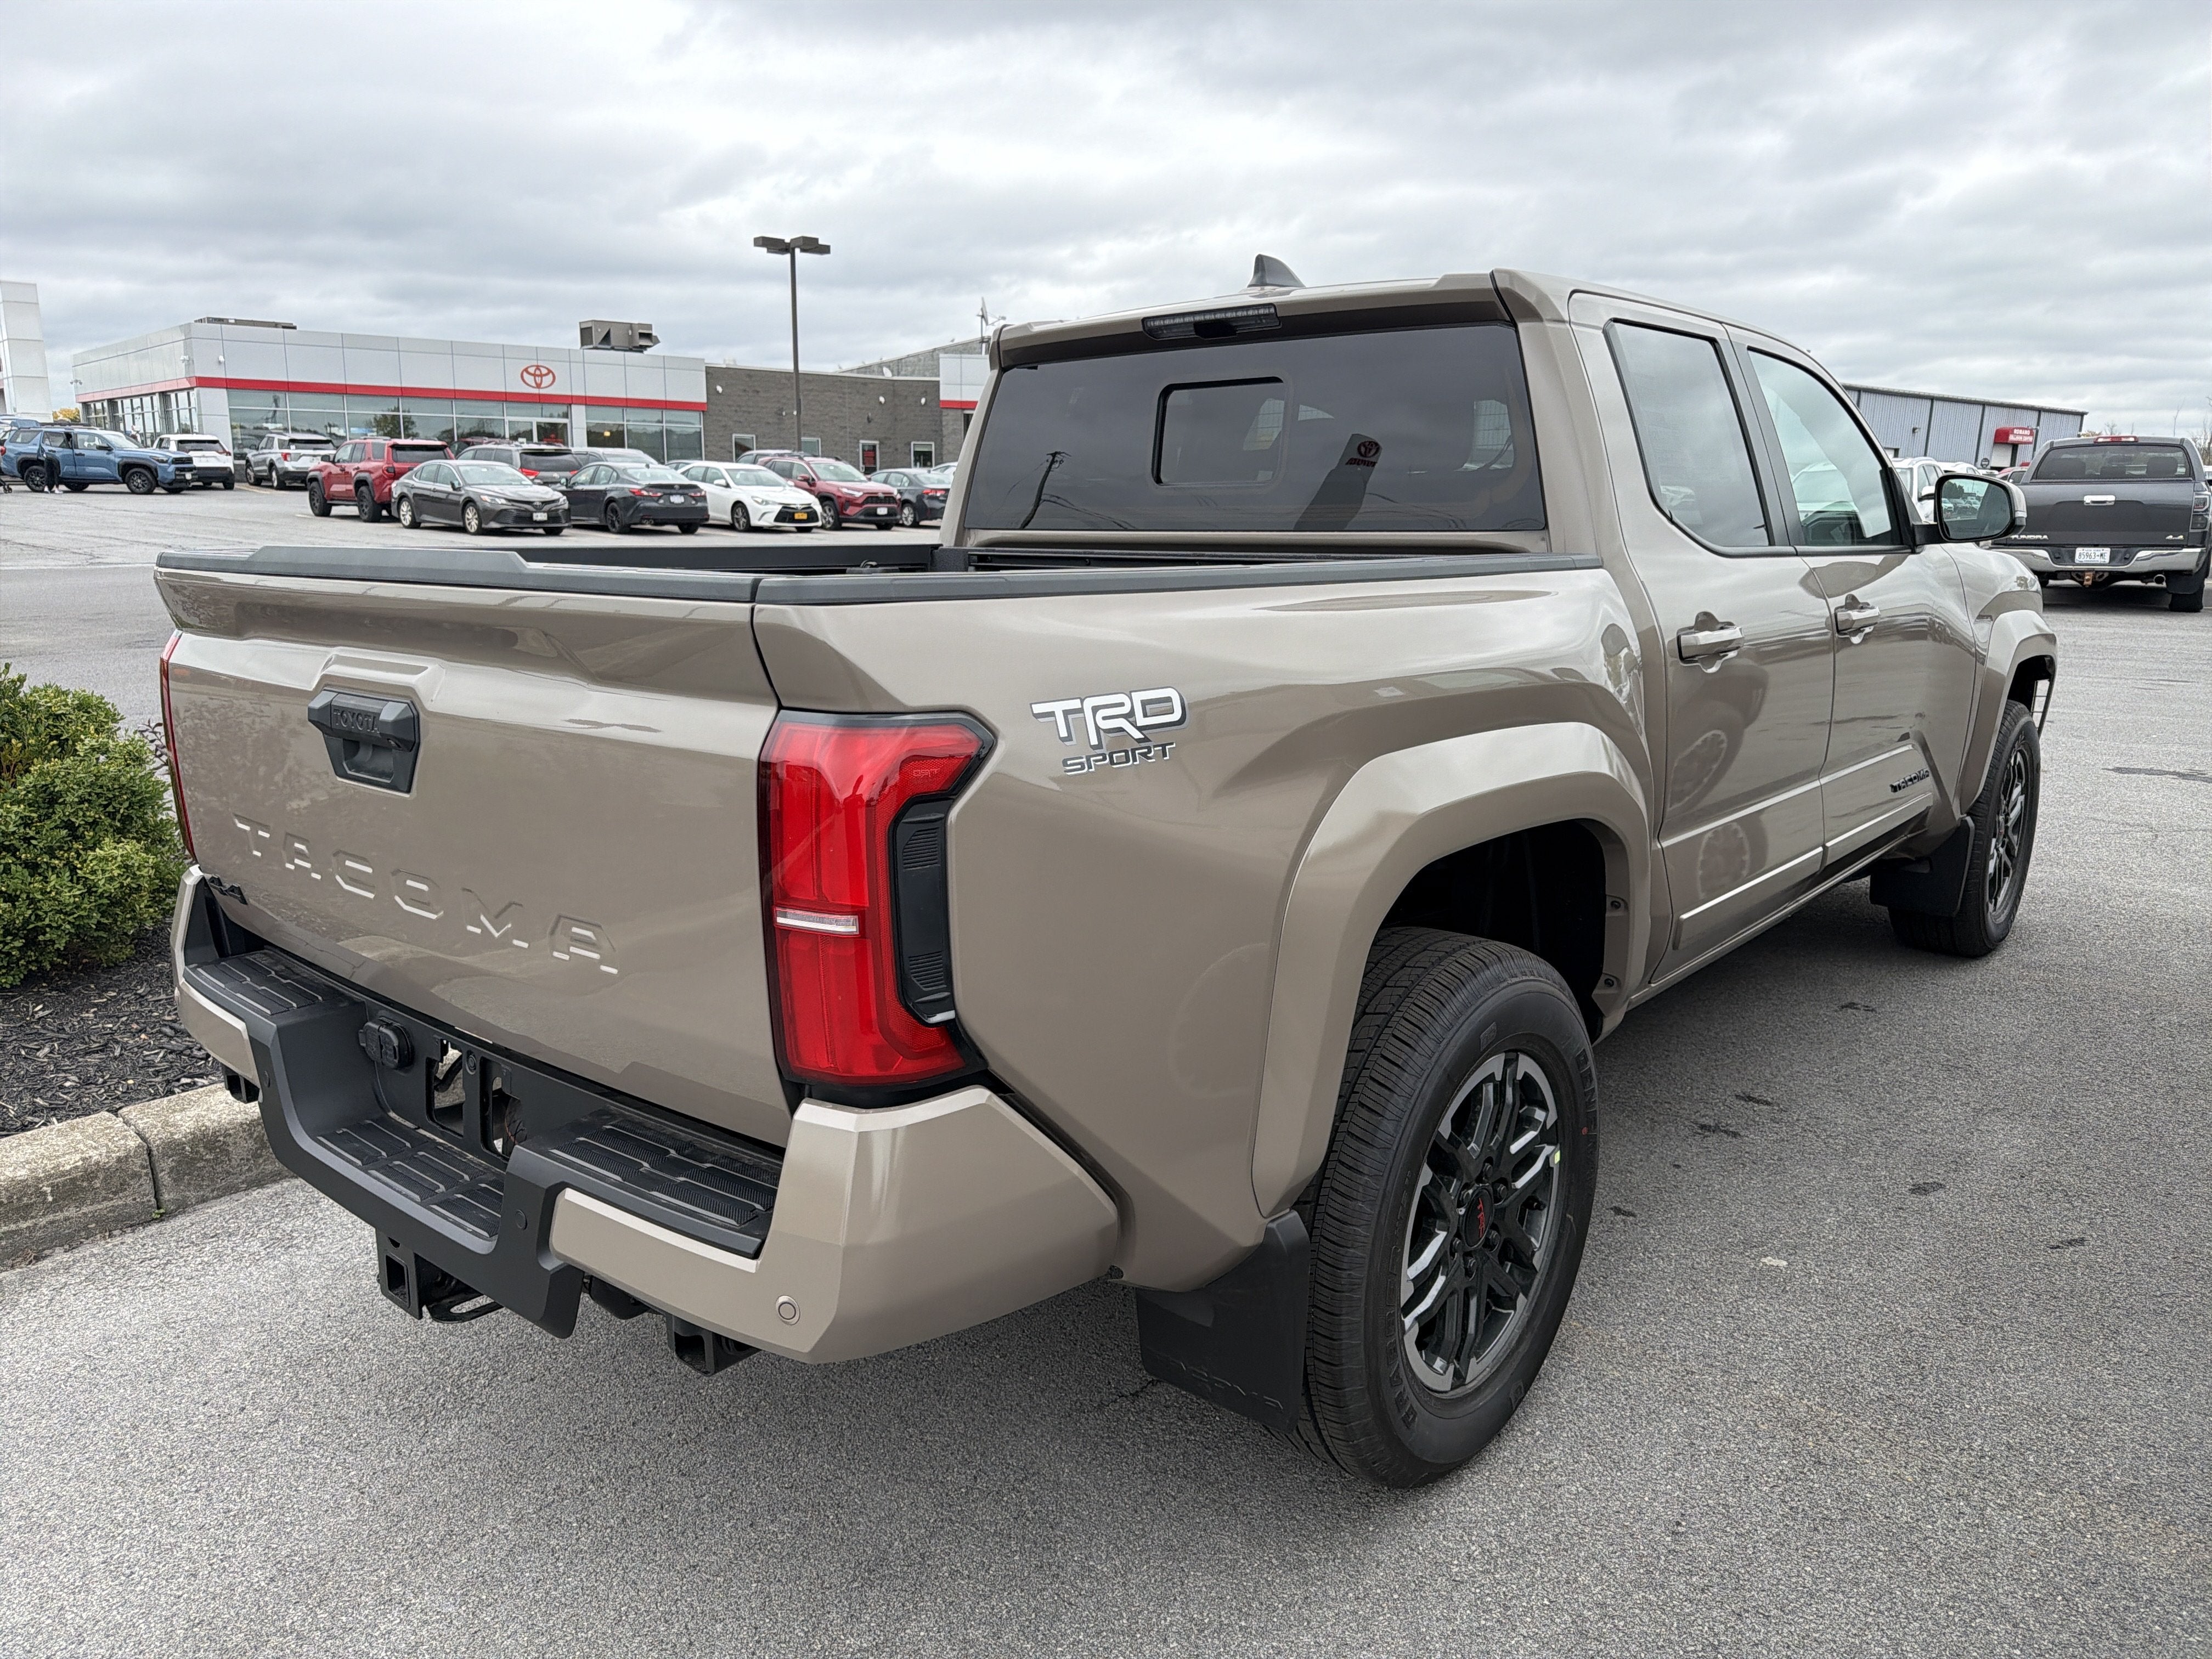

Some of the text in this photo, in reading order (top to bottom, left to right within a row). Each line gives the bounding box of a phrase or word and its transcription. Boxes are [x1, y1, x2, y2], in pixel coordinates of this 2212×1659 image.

[333, 708, 381, 734] TOYOTA
[1030, 686, 1188, 751] TRD
[1062, 742, 1176, 775] SPORT
[1889, 768, 1929, 793] TACOMA
[231, 812, 618, 975] TACOMA
